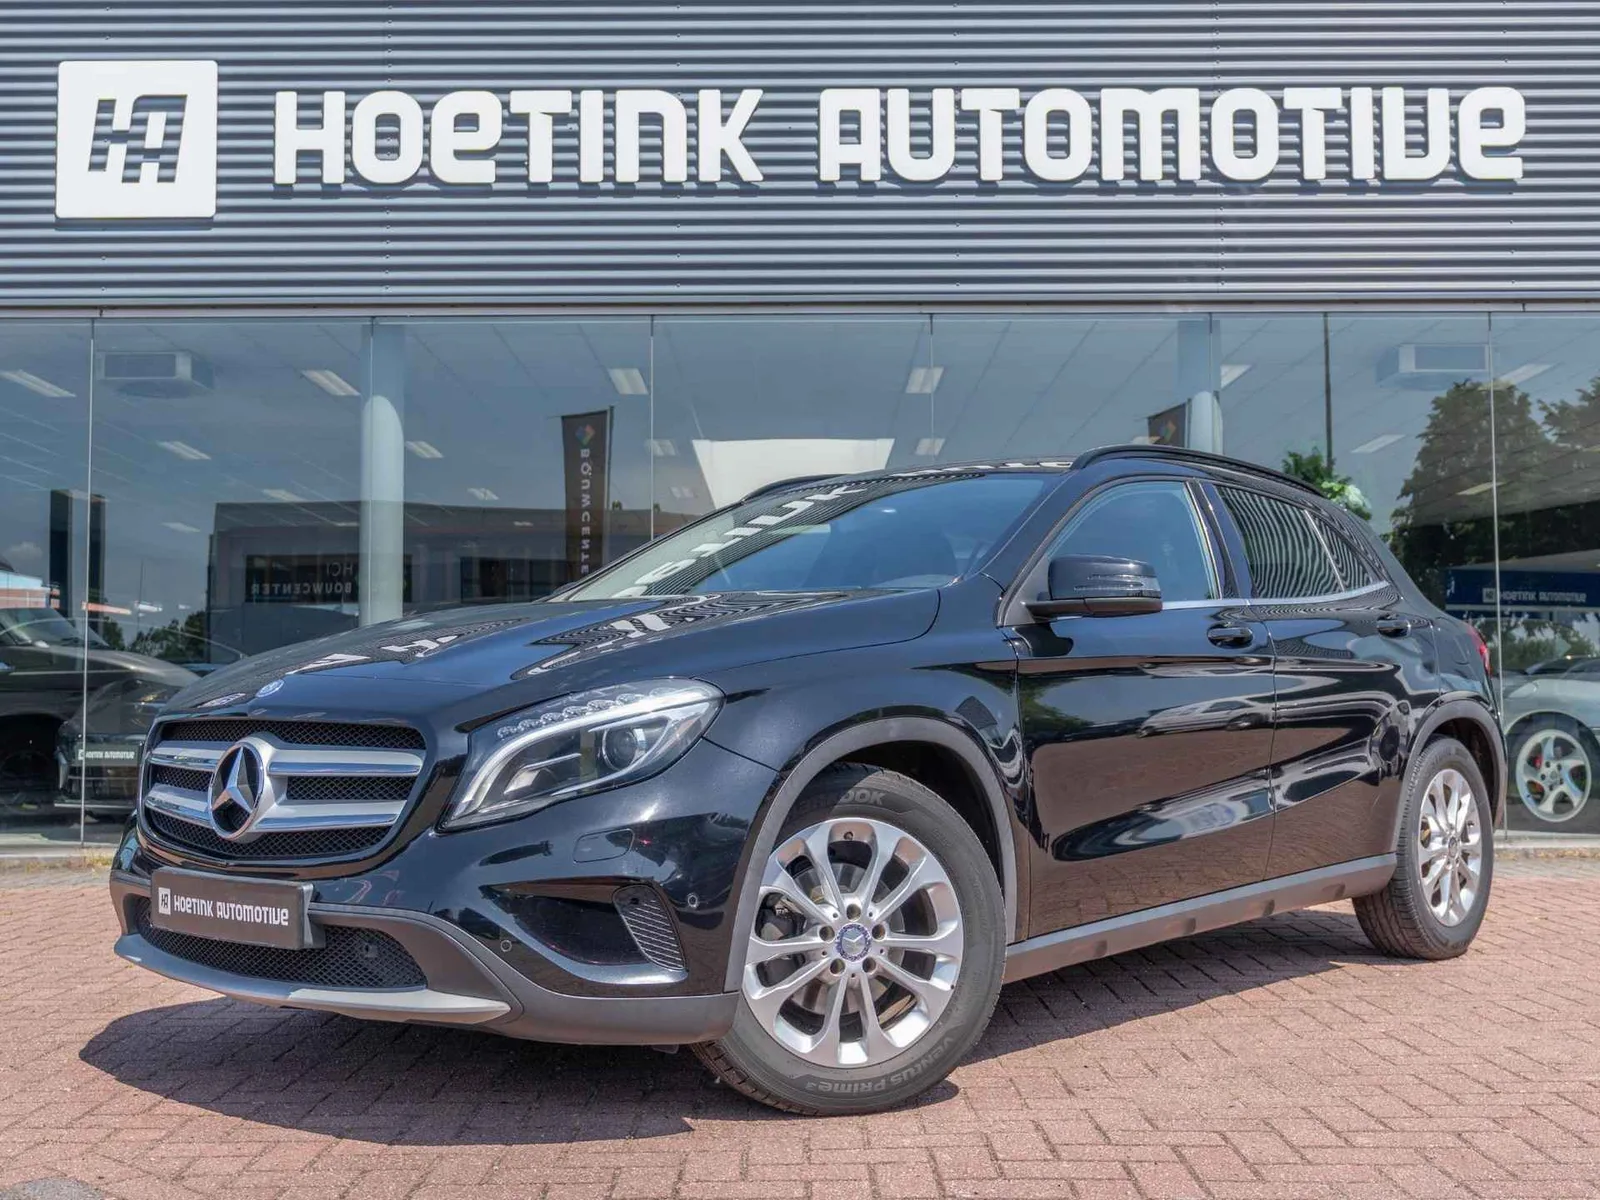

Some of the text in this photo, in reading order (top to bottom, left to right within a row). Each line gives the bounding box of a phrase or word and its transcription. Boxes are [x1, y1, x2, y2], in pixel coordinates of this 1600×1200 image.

[274, 86, 1526, 185] HOETINK AUTOMOTIVE
[173, 894, 214, 918] HOETINK
[216, 901, 289, 927] AUTOMOTIVE
